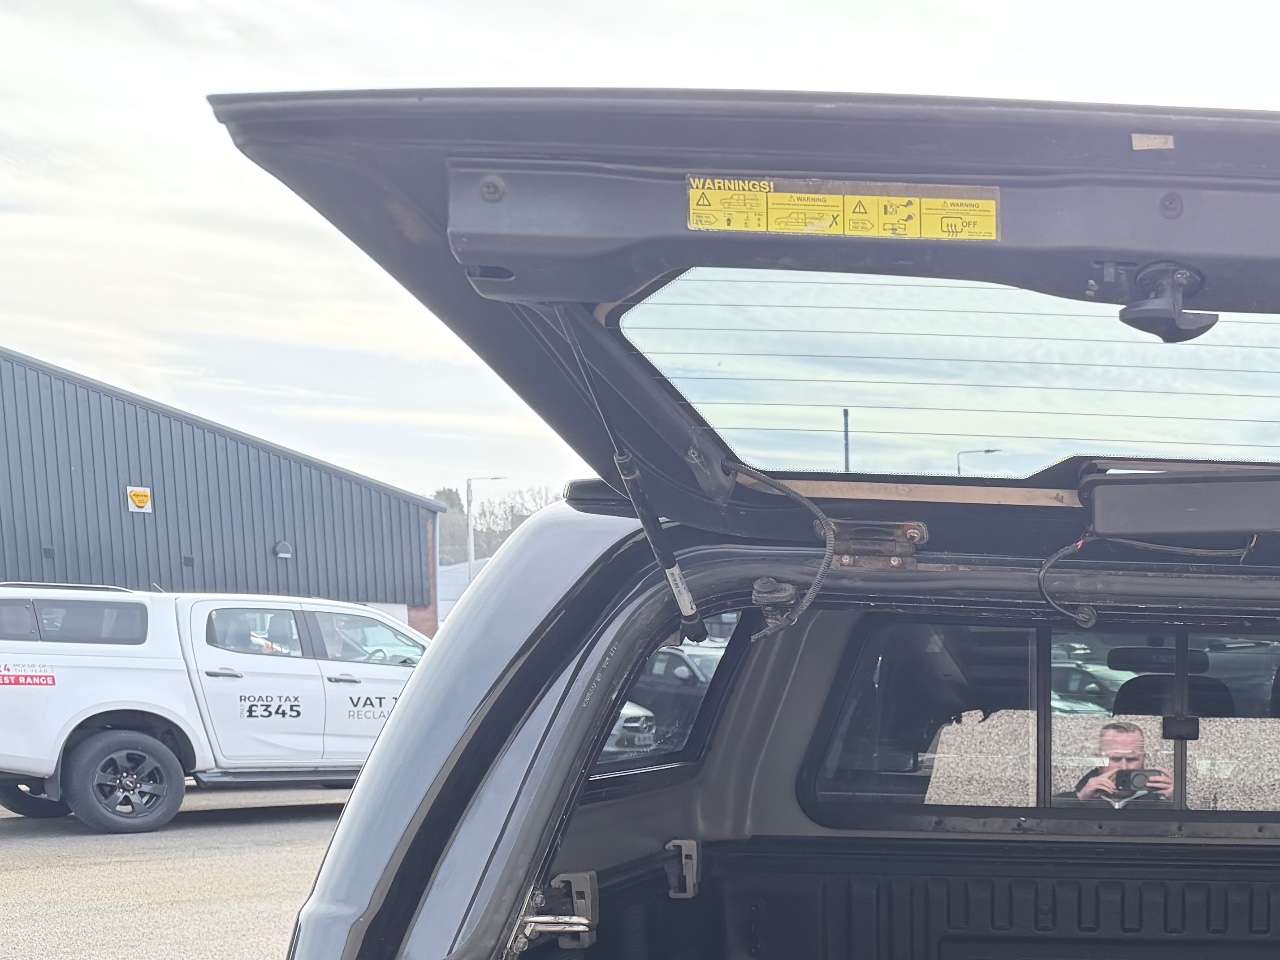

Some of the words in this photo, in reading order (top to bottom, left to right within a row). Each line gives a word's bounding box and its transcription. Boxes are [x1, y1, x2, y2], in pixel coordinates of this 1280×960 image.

[690, 178, 774, 193] WARNINGS!
[796, 196, 828, 204] WARNING
[18, 676, 54, 684] RANGE
[239, 695, 274, 703] ROAD
[276, 695, 301, 703] TAX
[349, 696, 387, 708] VAT
[246, 704, 302, 718] £345
